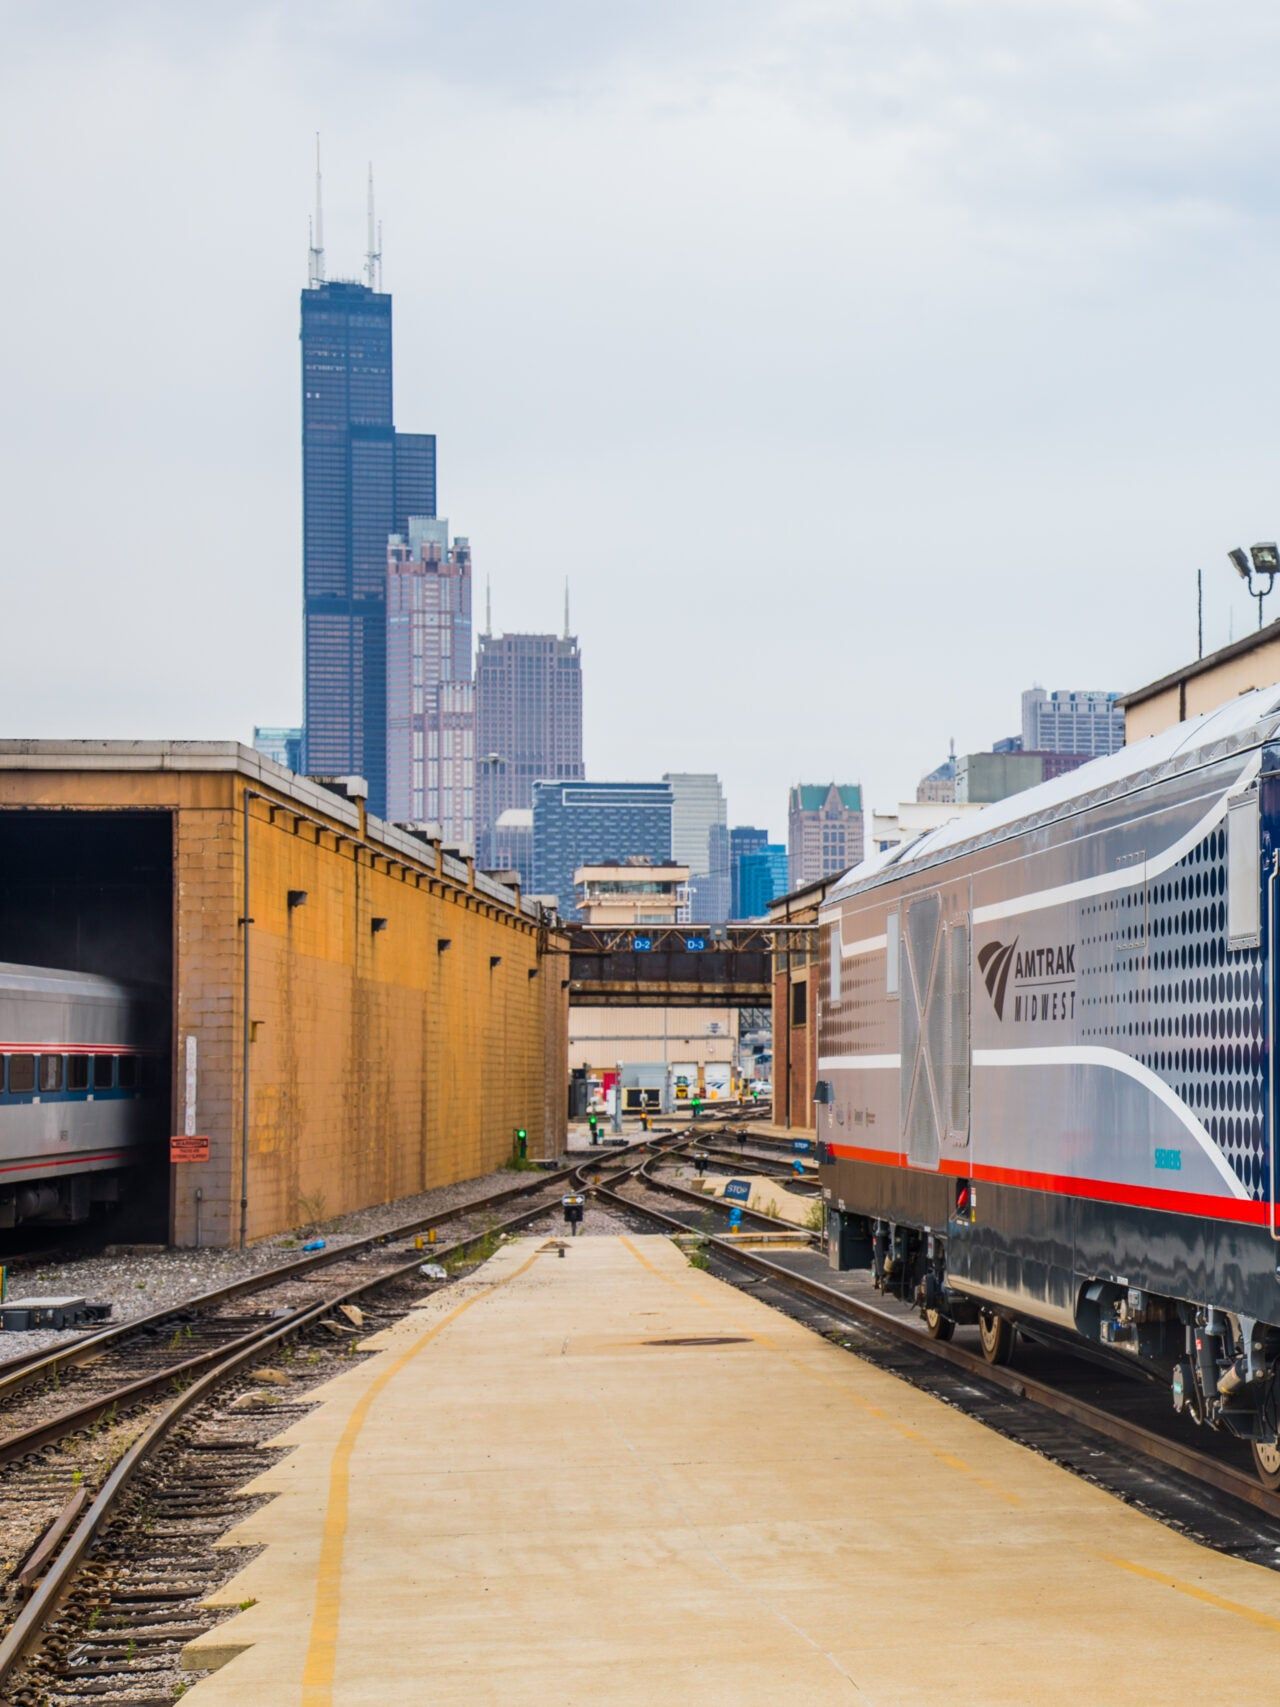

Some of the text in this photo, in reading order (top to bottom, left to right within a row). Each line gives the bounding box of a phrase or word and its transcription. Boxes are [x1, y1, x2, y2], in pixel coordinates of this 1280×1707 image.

[634, 940, 651, 949] D-2
[687, 940, 704, 949] D-3
[1014, 944, 1076, 979] AMTRAK
[1014, 991, 1076, 1022] MIDWEST
[727, 1184, 749, 1194] STOP
